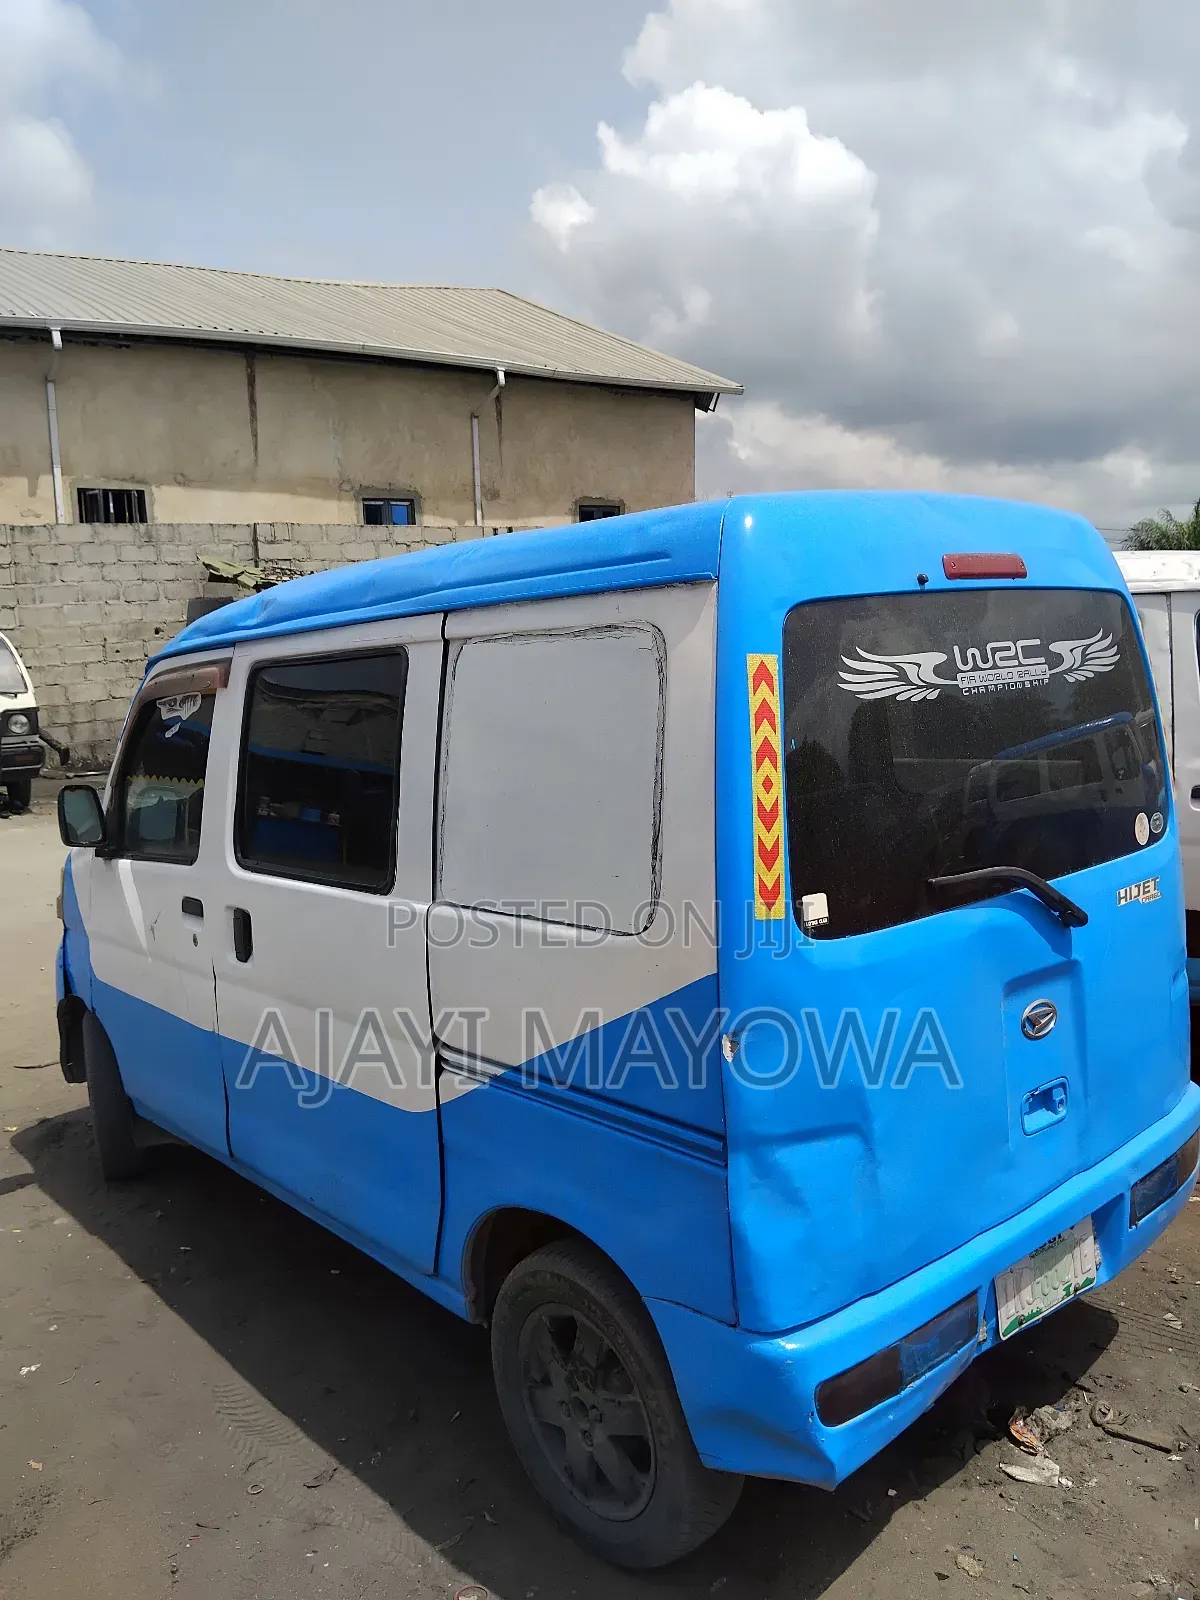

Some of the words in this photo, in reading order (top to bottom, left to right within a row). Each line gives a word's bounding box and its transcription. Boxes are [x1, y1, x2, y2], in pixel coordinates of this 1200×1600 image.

[953, 638, 1046, 671] WRC
[960, 675, 977, 685] FIA
[978, 671, 1014, 685] WORLD
[1017, 668, 1047, 680] RALLY
[962, 678, 1050, 696] CHAMPIONSHIP
[1117, 876, 1160, 906] HIJET
